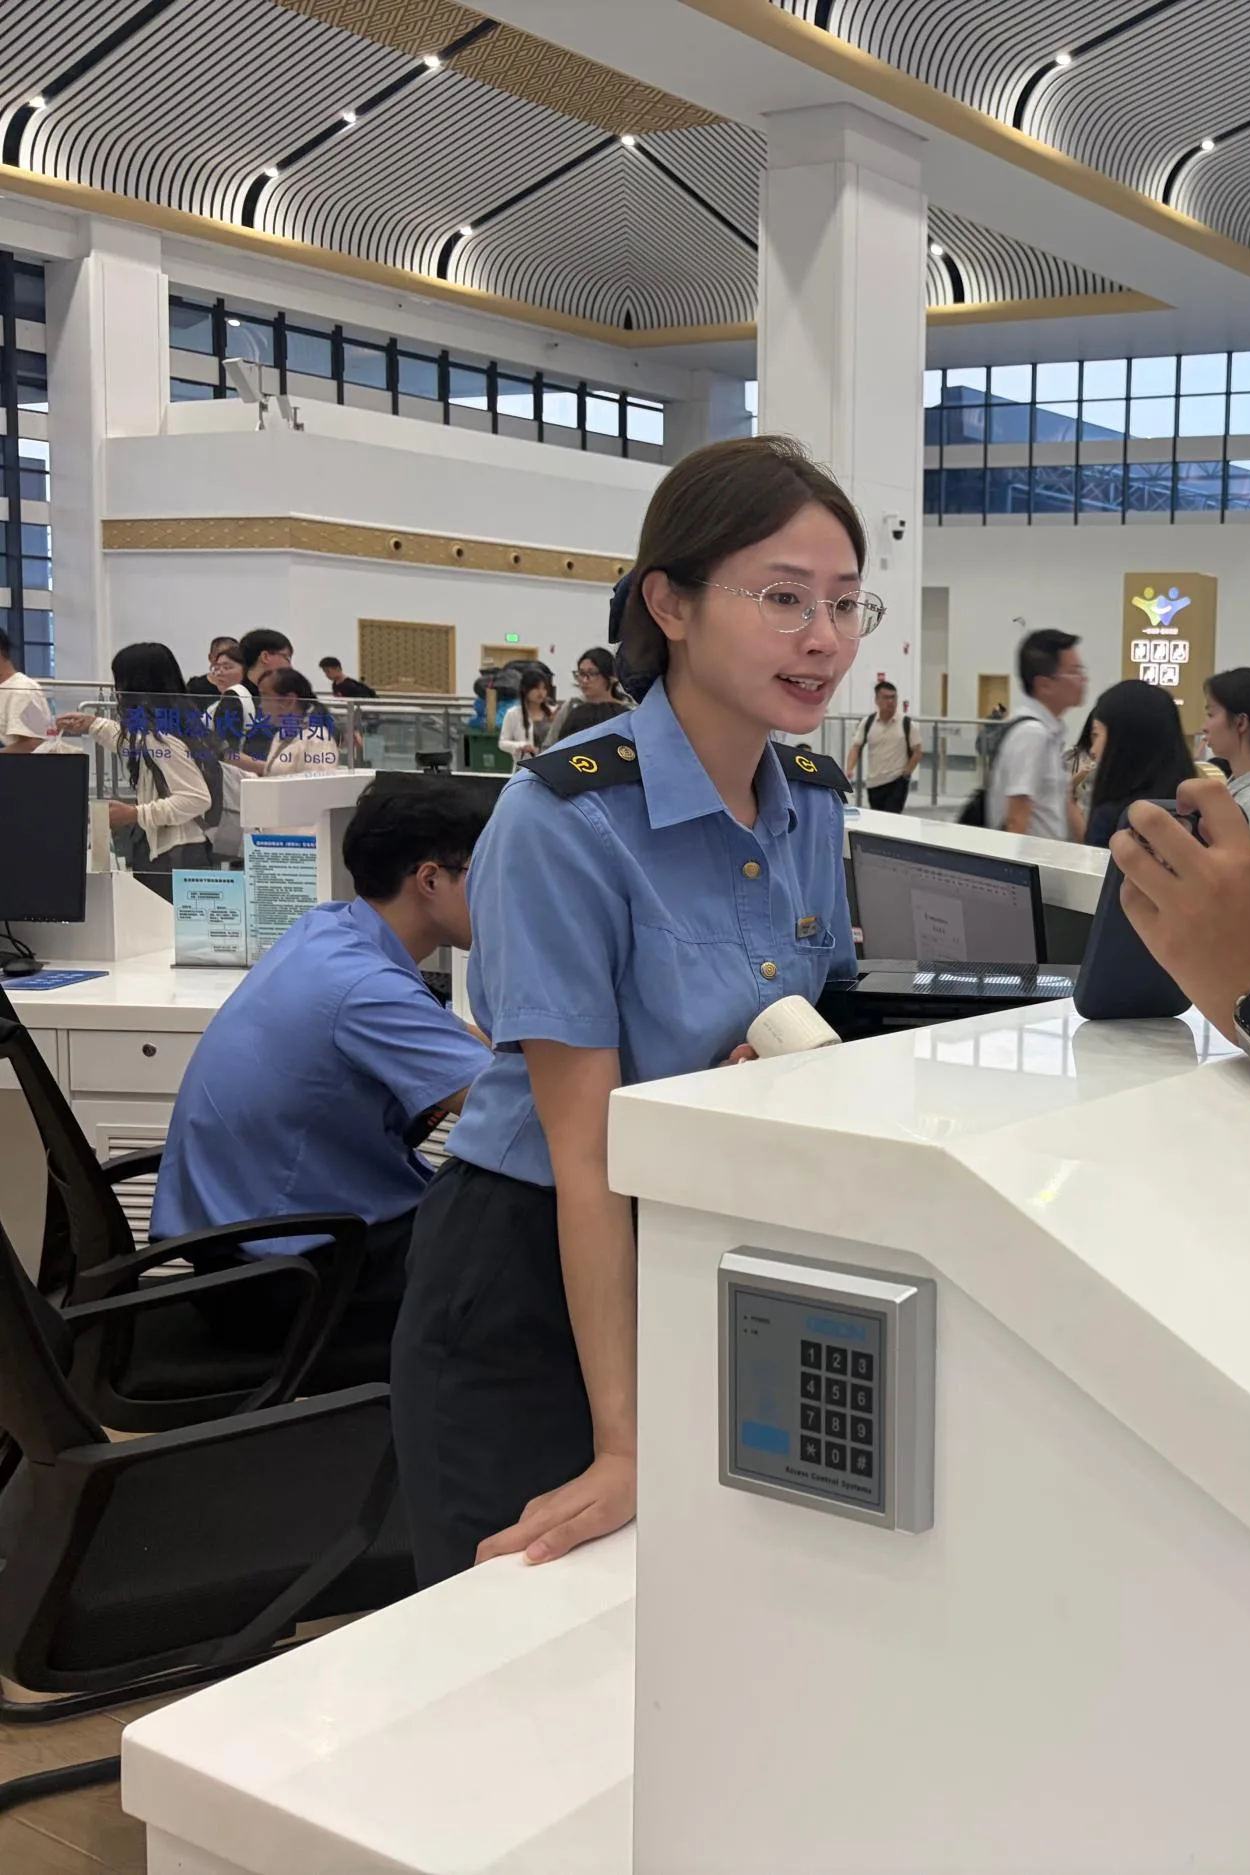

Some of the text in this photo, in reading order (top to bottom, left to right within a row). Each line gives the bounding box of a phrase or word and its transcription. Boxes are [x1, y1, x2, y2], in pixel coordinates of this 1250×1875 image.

[808, 1347, 867, 1374] 1 2 3
[806, 1380, 866, 1407] 4 5 6
[806, 1411, 866, 1438] 7 8 9
[831, 1448, 840, 1464] 0
[785, 1465, 872, 1494] Access Control Systems
